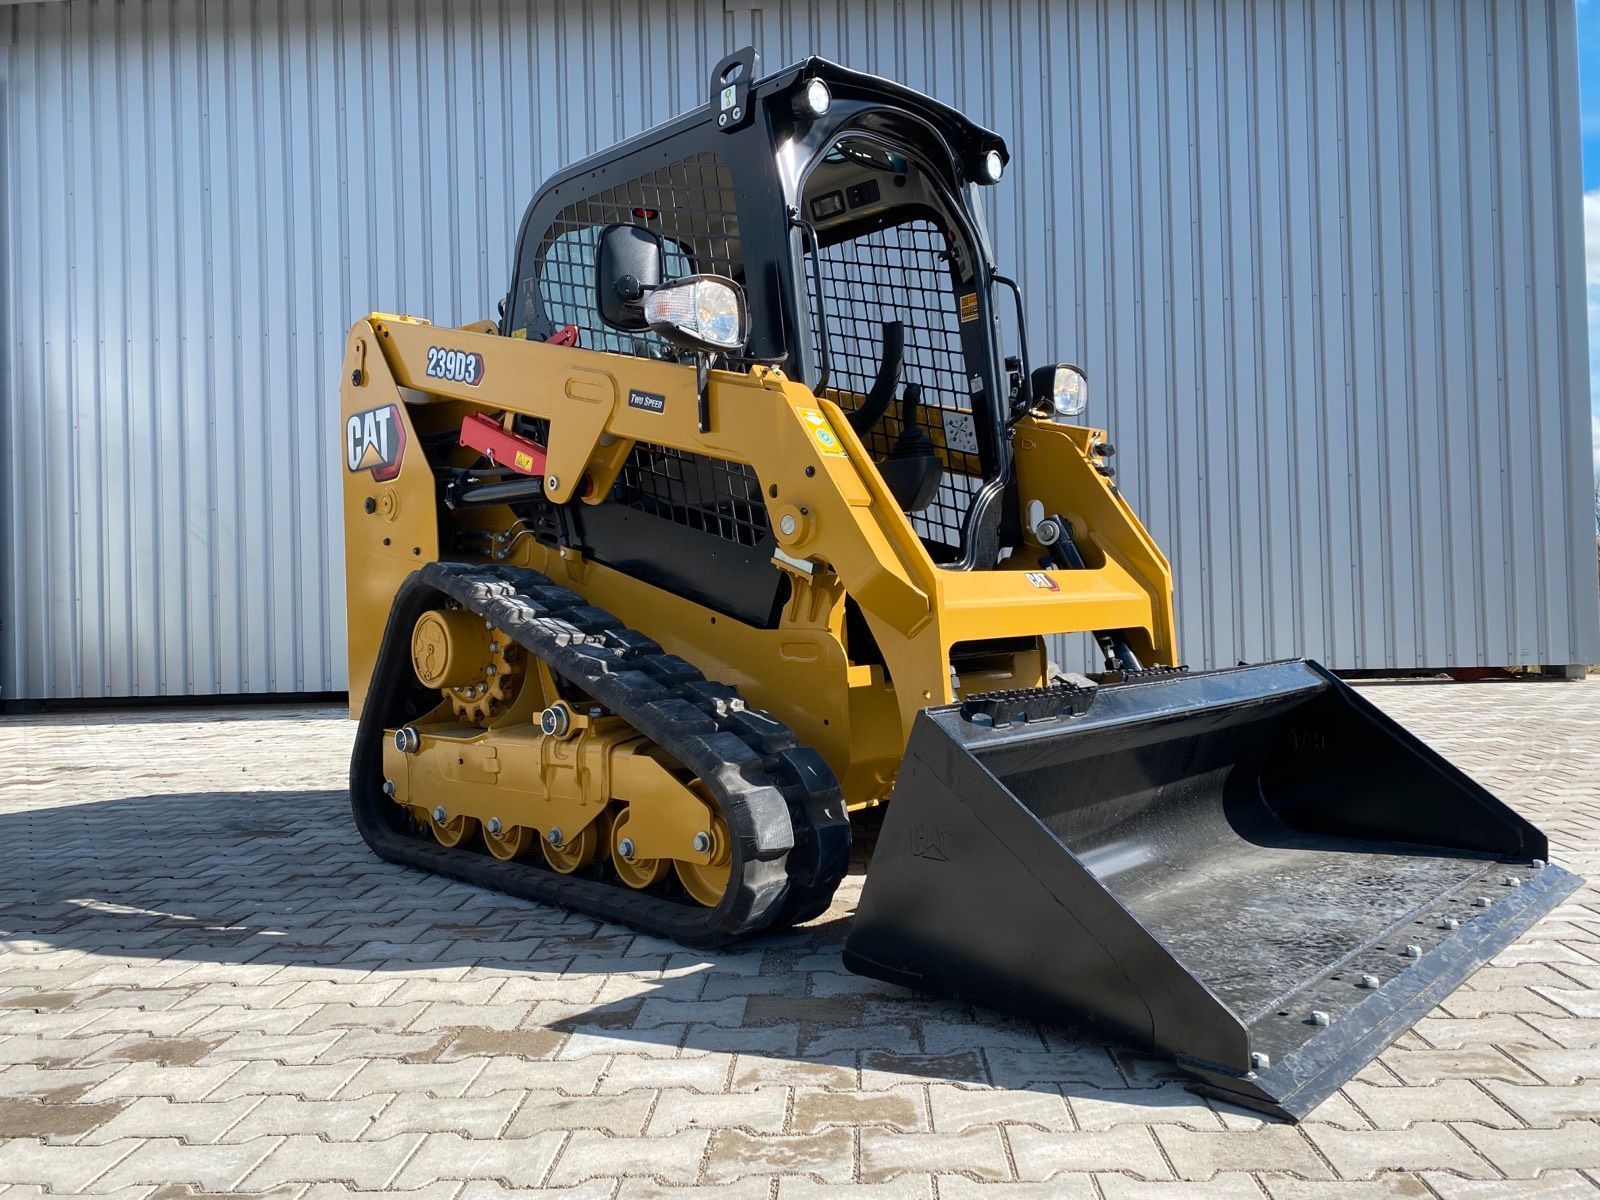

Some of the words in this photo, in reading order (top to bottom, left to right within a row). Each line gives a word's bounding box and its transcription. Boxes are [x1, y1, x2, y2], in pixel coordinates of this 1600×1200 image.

[427, 348, 476, 384] 239D3
[644, 396, 663, 409] SPEED
[347, 406, 391, 470] CAT
[1025, 573, 1053, 588] CAT
